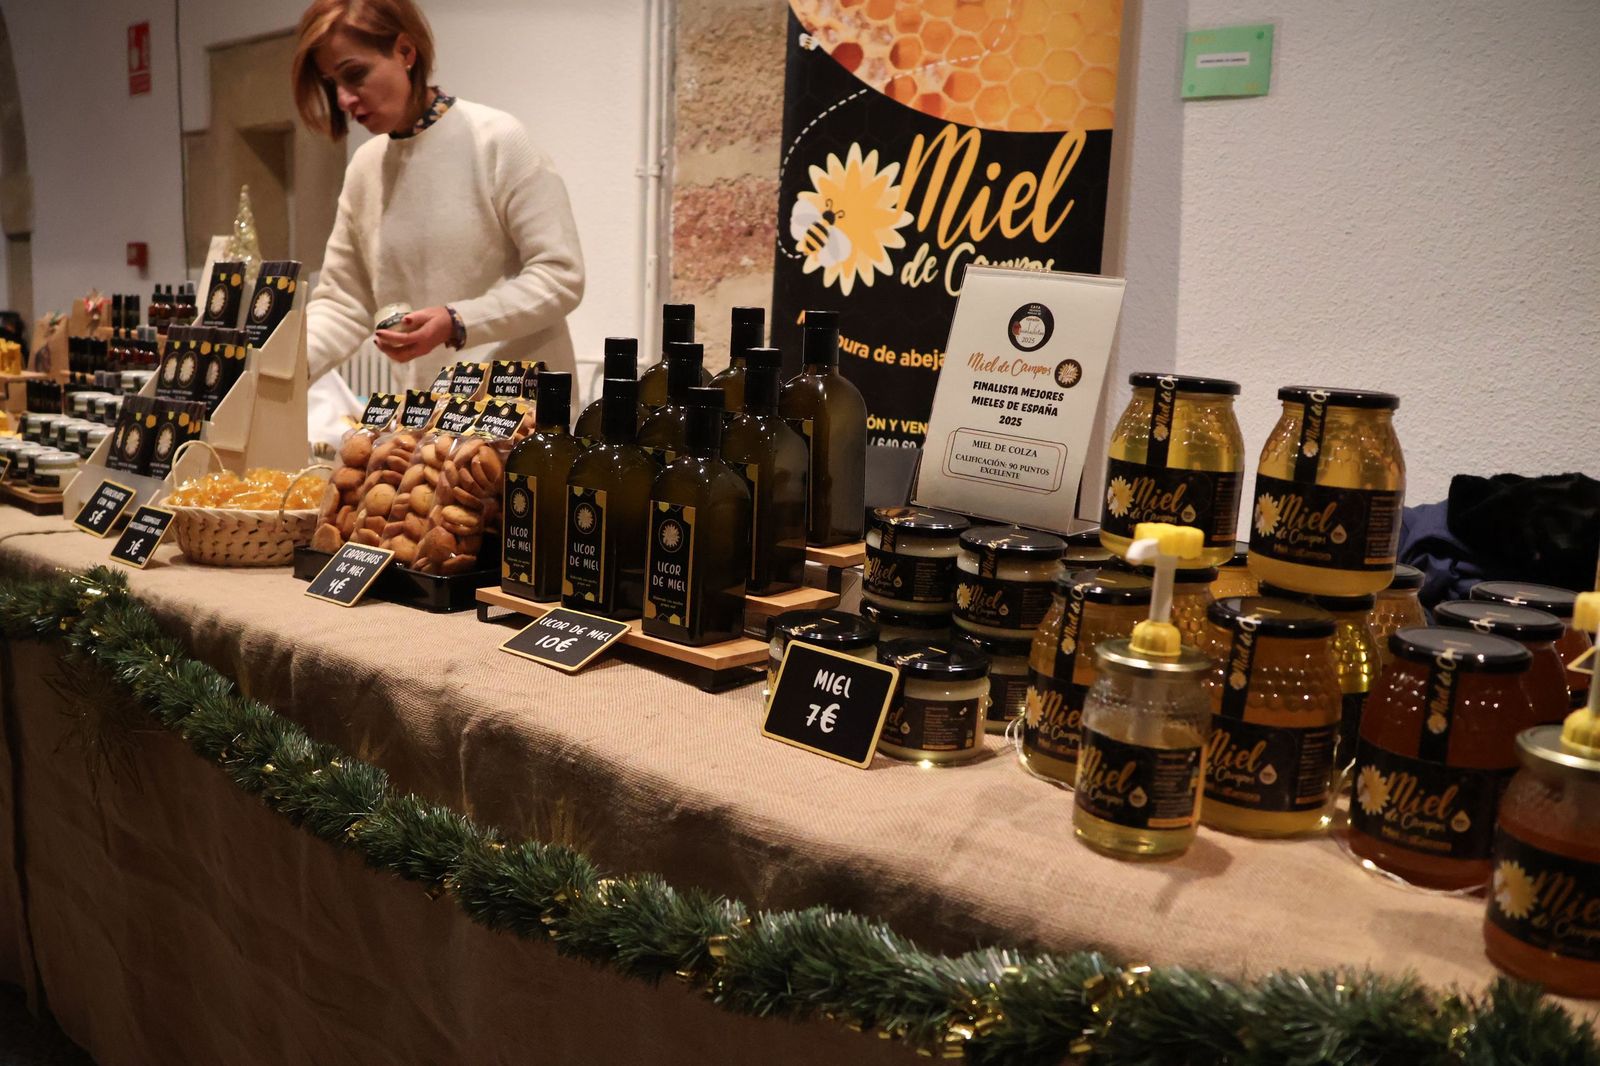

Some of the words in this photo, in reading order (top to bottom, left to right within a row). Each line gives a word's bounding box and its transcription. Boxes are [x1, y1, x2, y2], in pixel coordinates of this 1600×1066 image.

[899, 124, 1087, 250] Miel
[900, 243, 939, 288] de
[873, 345, 896, 364] de
[967, 352, 1000, 373] Miel
[997, 361, 1010, 373] de
[1011, 359, 1052, 380] Campos
[492, 375, 523, 384] CAPRICHOS
[495, 385, 503, 393] DE
[505, 385, 518, 394] MIEL
[973, 381, 1018, 395] FINALISTA
[1021, 388, 1064, 402] MEJORES
[971, 396, 1005, 409] MIELES
[1006, 400, 1018, 411] DE
[1021, 403, 1058, 417] ESPAÑA
[442, 421, 451, 430] DE
[443, 412, 474, 424] CAPRICHOS
[482, 415, 517, 428] CAPRICHOS
[889, 419, 898, 432] Y
[999, 415, 1022, 427] 2025
[481, 424, 491, 432] DE
[491, 426, 506, 436] MIEL
[972, 440, 992, 450] MIEL
[994, 443, 1006, 453] DE
[1008, 446, 1038, 458] COLZA
[955, 453, 1007, 469] CALIFICACIÓN:
[1019, 465, 1050, 476] PUNTOS
[980, 466, 1020, 479] EXCELENTE
[1131, 476, 1187, 513] Miel
[88, 509, 107, 525] 5€
[1278, 493, 1338, 532] Miel
[510, 525, 529, 539] LICOR
[506, 538, 515, 549] DE
[518, 542, 531, 553] MIEL
[573, 542, 596, 557] LICOR
[342, 548, 383, 565] CAPRICHOS
[569, 555, 580, 567] DE
[583, 558, 599, 572] MIEL
[335, 562, 350, 573] DE
[347, 564, 366, 577] MIEL
[657, 560, 682, 576] LICOR
[328, 577, 350, 595] 4€
[652, 574, 664, 587] DE
[668, 577, 686, 592] MIEL
[539, 617, 566, 631] LICOR
[569, 623, 584, 636] DE
[587, 629, 613, 643] MIEL
[534, 634, 579, 653] 10€
[813, 668, 852, 699] MIEL
[805, 703, 841, 733] 7€
[1041, 690, 1081, 730] Mie
[1206, 729, 1267, 772] Miel
[1386, 772, 1459, 819] Miel
